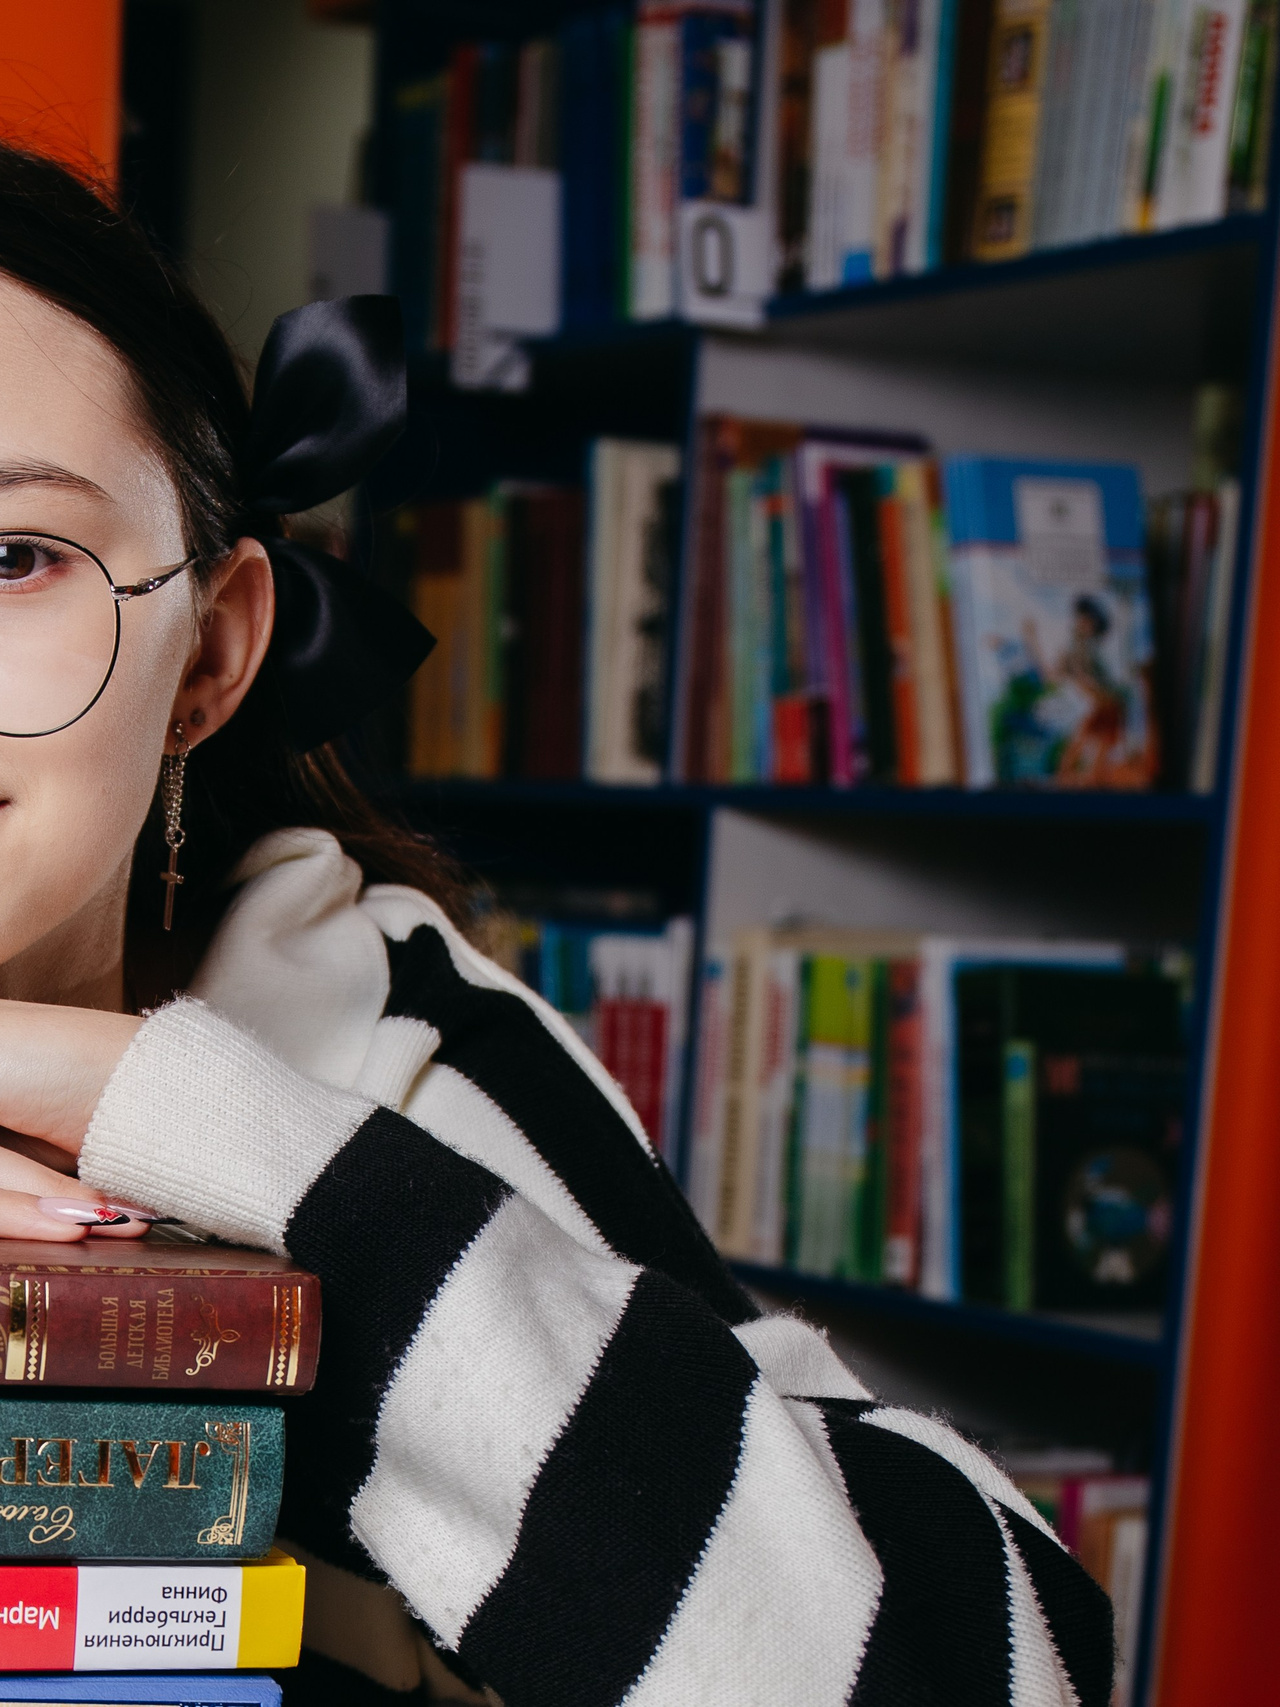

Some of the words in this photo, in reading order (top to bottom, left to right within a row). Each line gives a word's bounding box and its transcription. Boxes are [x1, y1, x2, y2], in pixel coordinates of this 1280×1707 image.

[98, 1296, 119, 1370] БОЛЬШАЯ
[126, 1300, 147, 1369] ДЕТСКАЯ
[152, 1288, 175, 1380] БИБЛИОТЕКА
[162, 1586, 228, 1603] Финна
[109, 1609, 226, 1629] Гекльберри
[84, 1634, 225, 1651] Приключения
